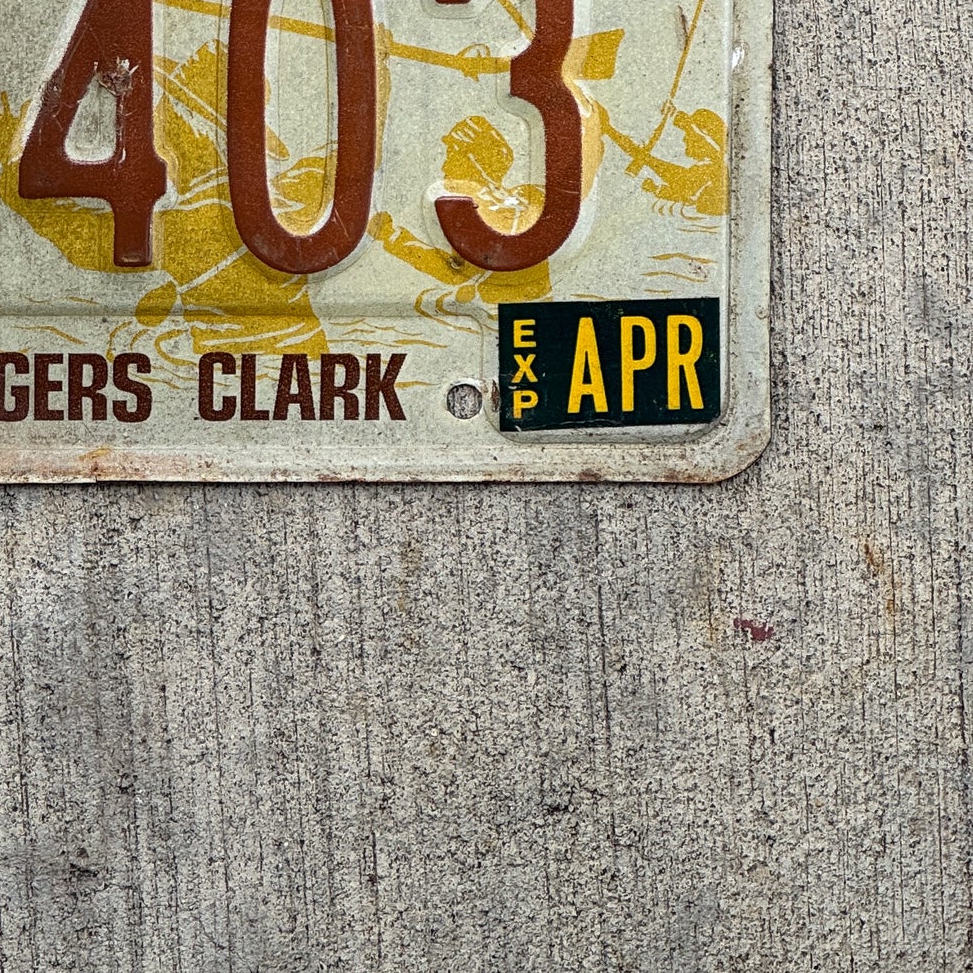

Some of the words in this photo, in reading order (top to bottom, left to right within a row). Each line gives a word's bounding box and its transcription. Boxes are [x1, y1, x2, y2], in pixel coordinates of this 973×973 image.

[198, 352, 408, 421] CLARK
[511, 319, 539, 419] EXP
[567, 314, 705, 414] APR
